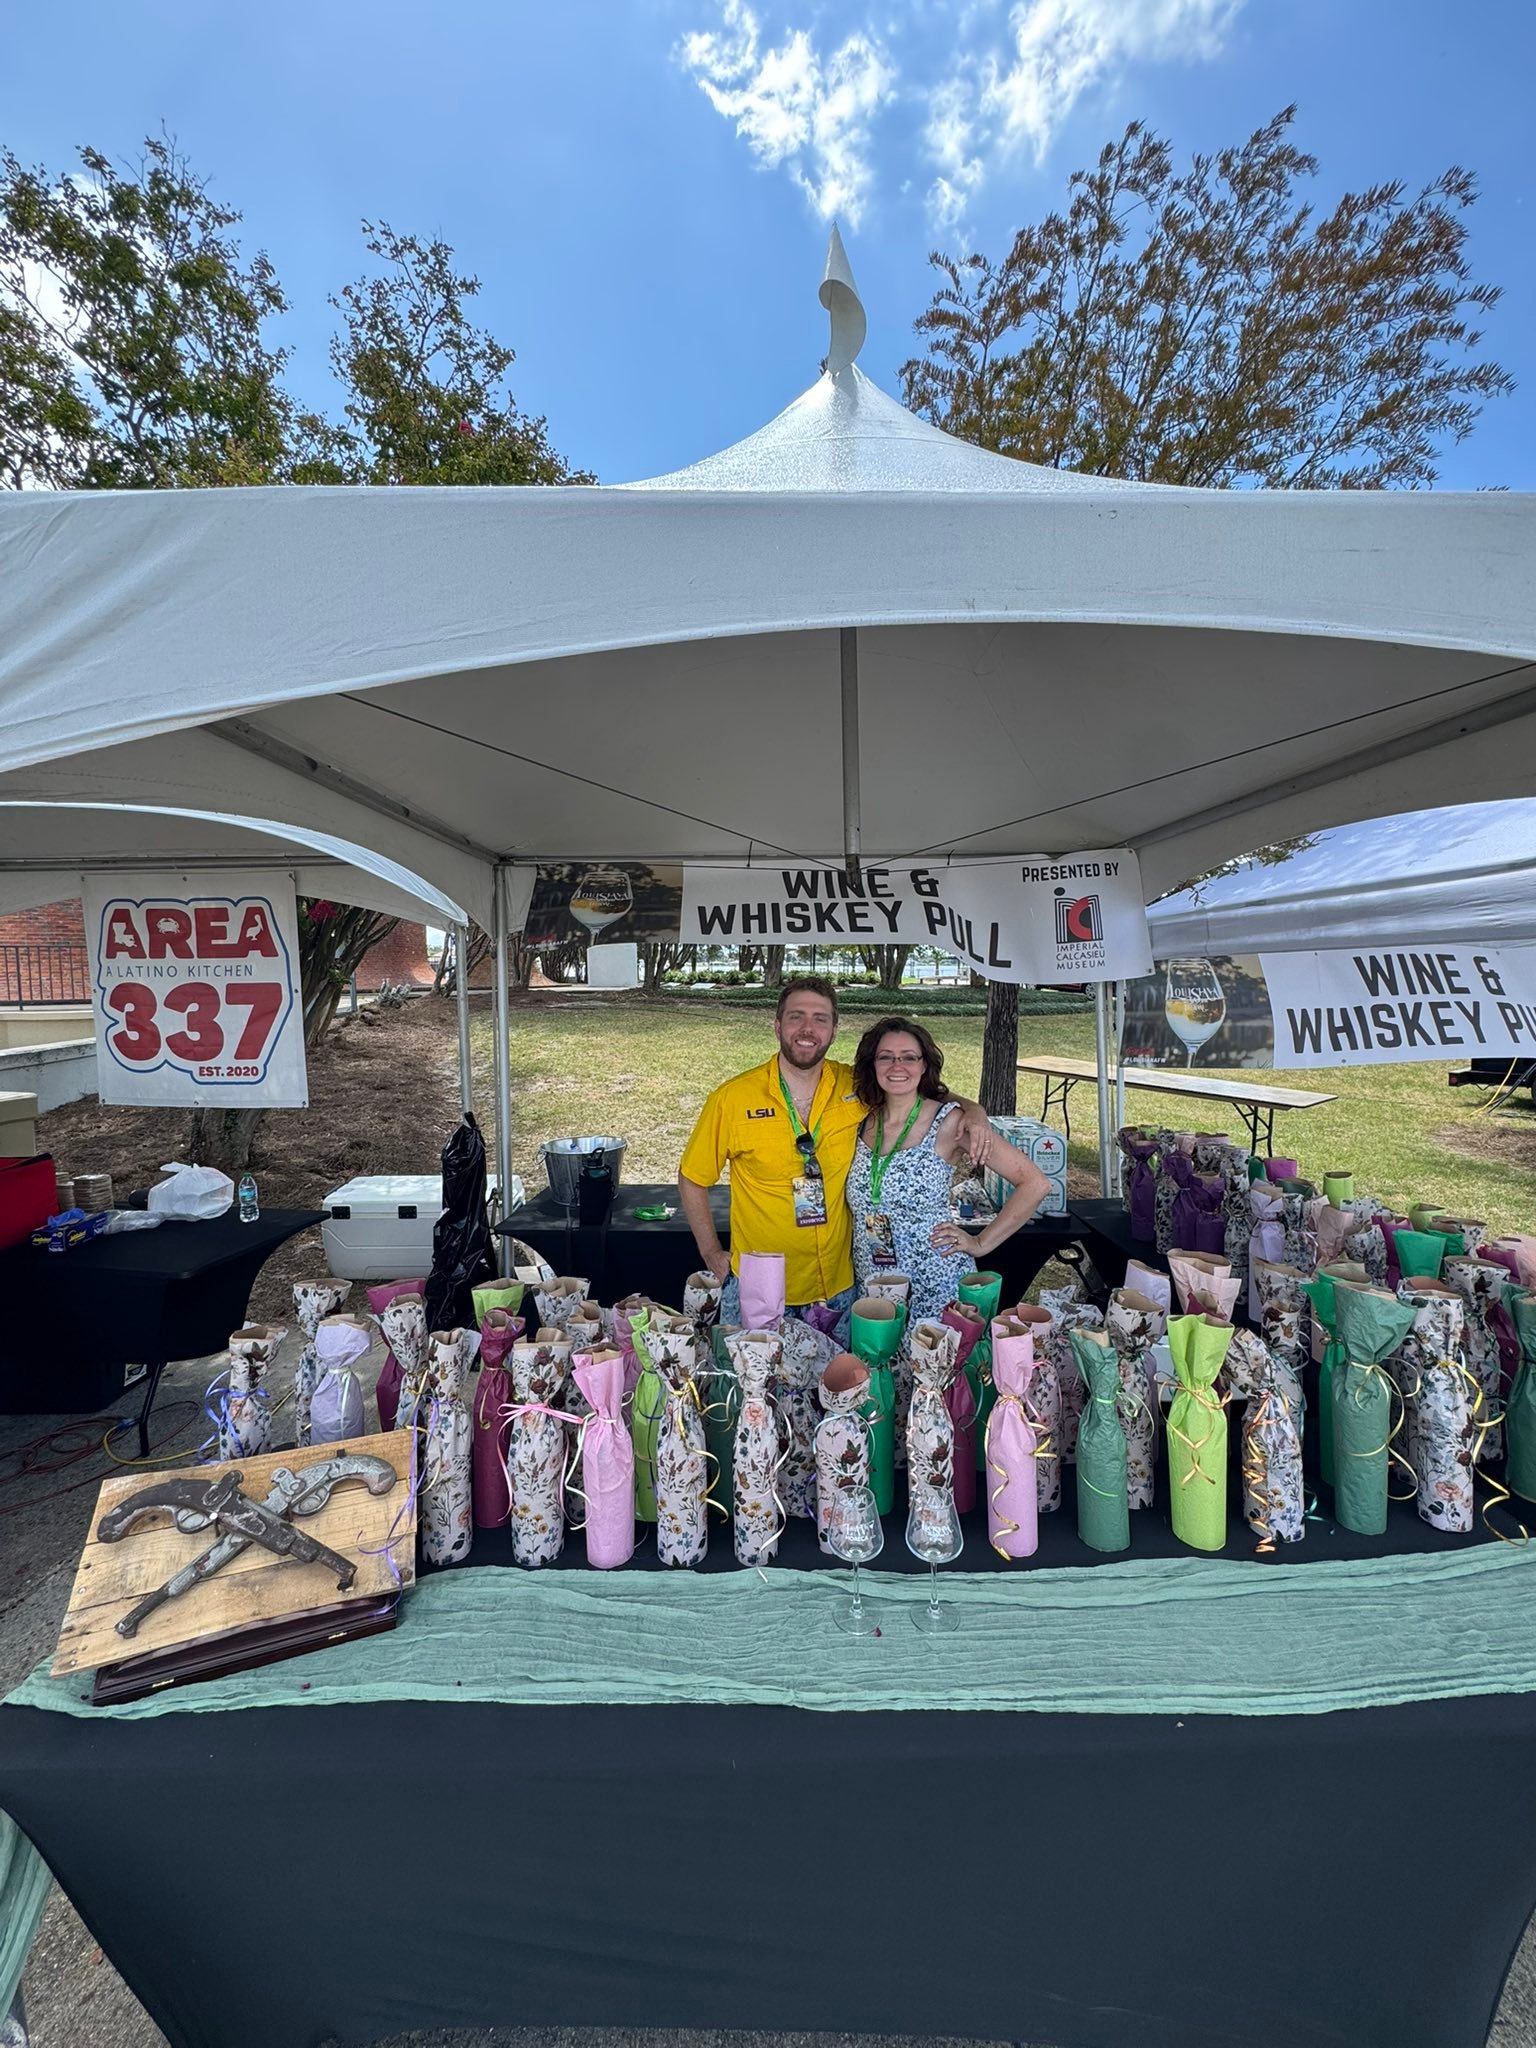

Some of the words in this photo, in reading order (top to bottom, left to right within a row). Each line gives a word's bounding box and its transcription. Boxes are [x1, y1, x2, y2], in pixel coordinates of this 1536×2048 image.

[1022, 863, 1100, 882] PRESENTED
[1104, 862, 1119, 877] BY
[782, 869, 895, 899] WINE
[910, 869, 940, 898] &
[105, 906, 279, 959] AREA
[697, 901, 903, 936] WHISKEY
[923, 901, 1012, 969] PULL
[1056, 942, 1104, 952] IMPERIAL
[1056, 950, 1105, 961] CALCASIEU
[105, 966, 113, 977] A
[117, 965, 178, 977] LATINO
[187, 965, 254, 977] KITCHEN
[1056, 960, 1105, 970] MUSEUM
[1352, 953, 1471, 997] WINE
[1472, 955, 1507, 996] &
[109, 982, 283, 1061] 337
[1286, 1001, 1487, 1053] WHISKEY
[1496, 1001, 1536, 1044] PU
[199, 1067, 224, 1077] EST.
[226, 1066, 259, 1077] 2020
[746, 1108, 776, 1119] LSU
